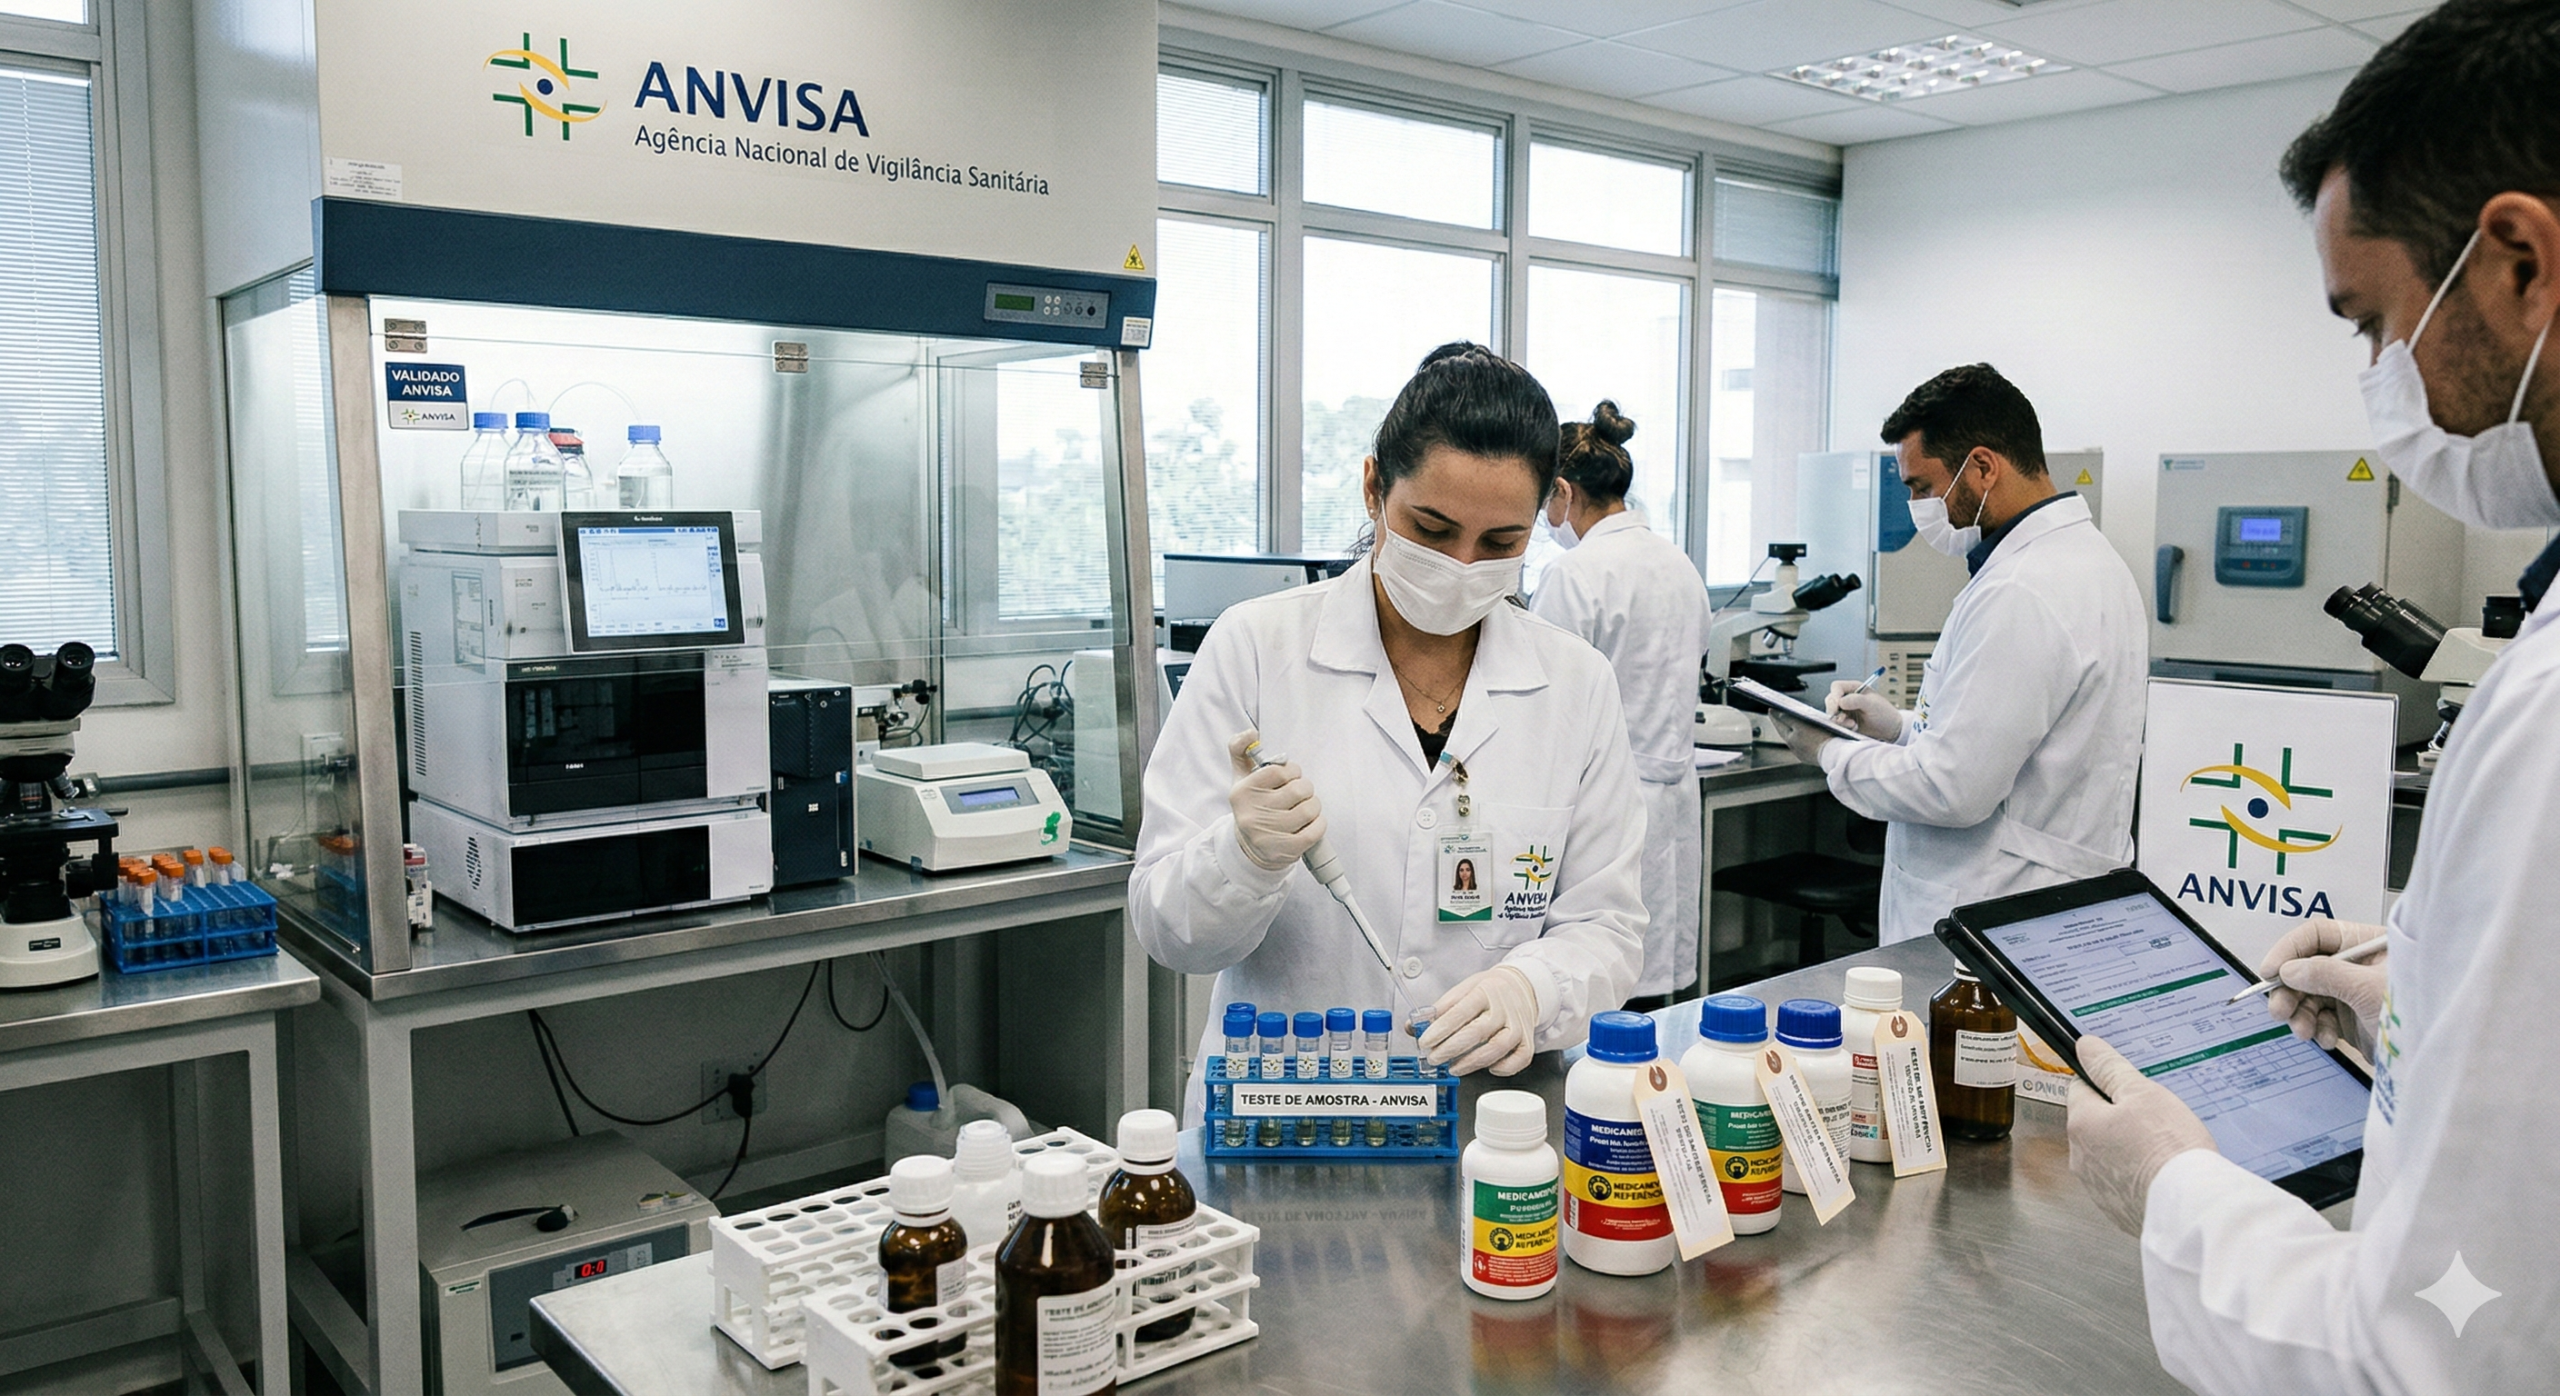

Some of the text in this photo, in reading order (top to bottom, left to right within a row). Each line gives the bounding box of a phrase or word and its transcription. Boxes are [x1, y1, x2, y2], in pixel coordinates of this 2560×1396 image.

[634, 60, 870, 137] ANVISA
[634, 124, 1049, 195] Agência Nacional de Vigilância Sanitária
[391, 369, 460, 383] VALIDADO
[401, 384, 453, 397] ANVISA
[2176, 872, 2336, 920] ANVISA
[1240, 1094, 1281, 1106] TESTE
[1285, 1094, 1302, 1106] DE
[1305, 1094, 1370, 1107] AMOSTRA
[1379, 1095, 1429, 1107] ANVISA
